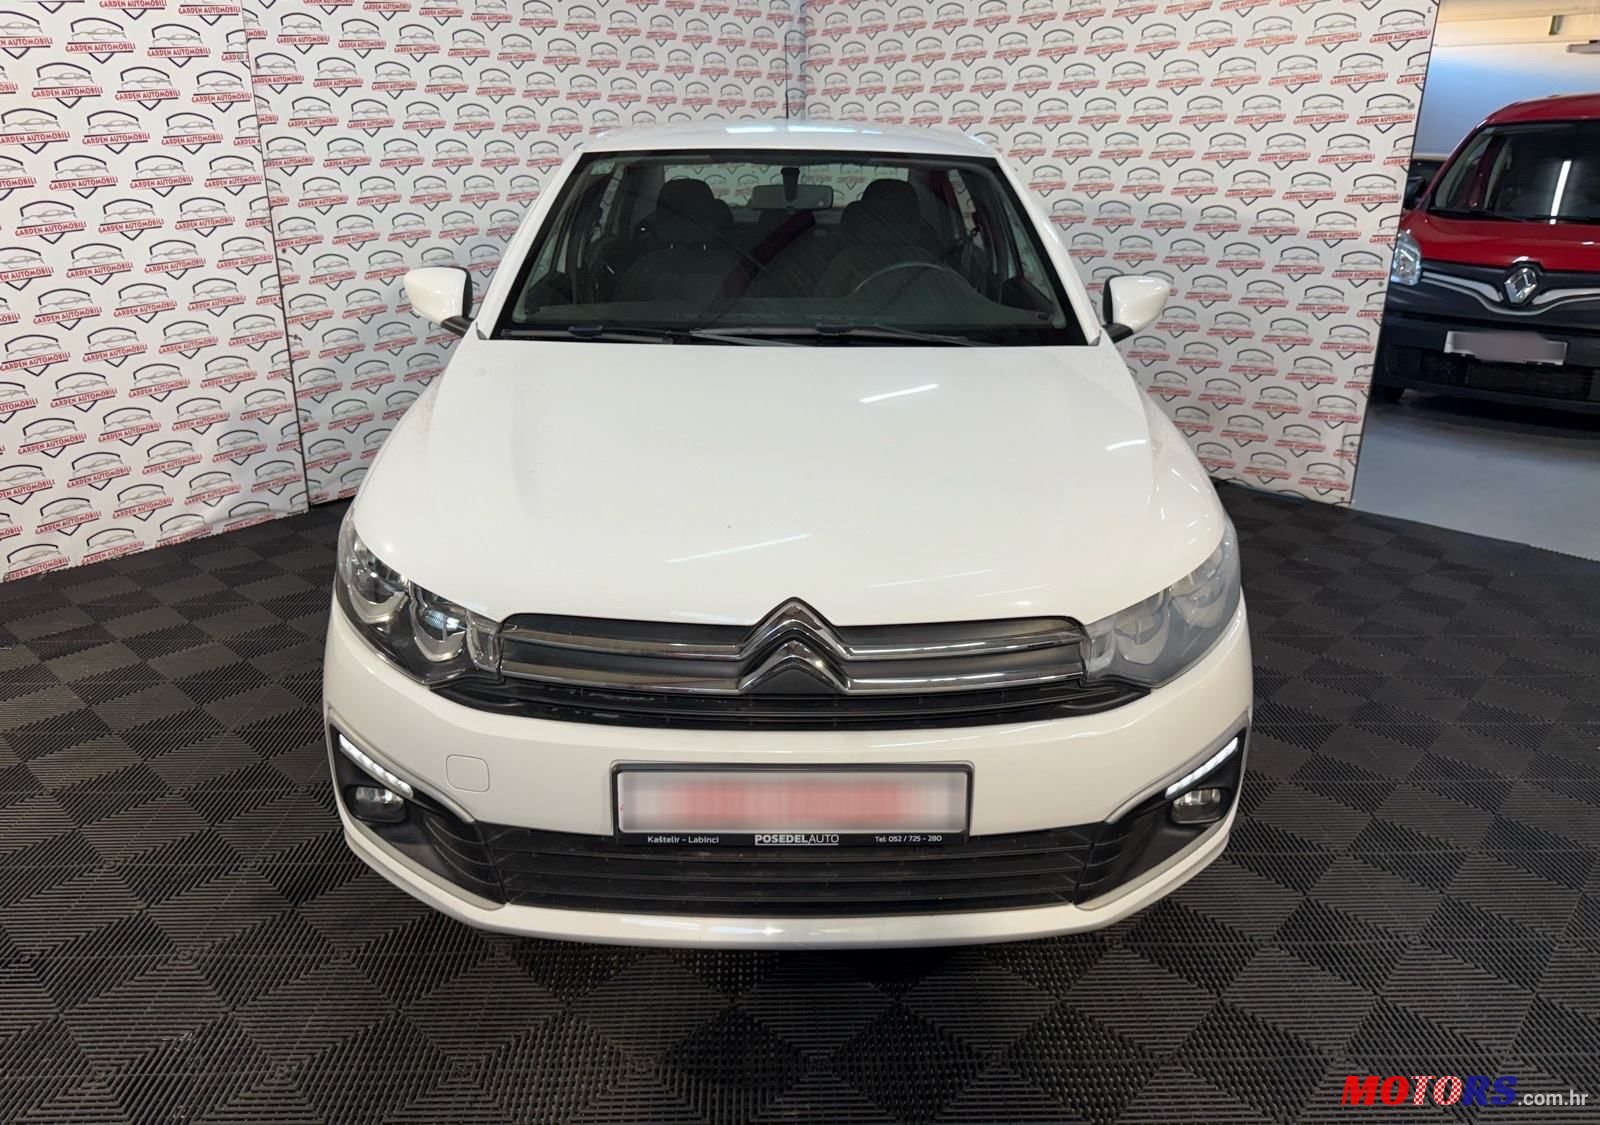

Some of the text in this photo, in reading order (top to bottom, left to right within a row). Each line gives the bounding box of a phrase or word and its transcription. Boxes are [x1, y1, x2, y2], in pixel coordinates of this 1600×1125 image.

[8, 37, 53, 46] AUTOMOBILI
[94, 42, 136, 51] AUTOMOBILI
[173, 47, 211, 55] AUTOMOBILI
[31, 86, 103, 98] GARDEN AUTOMOBILI
[115, 89, 181, 101] GARDEN AUTOMOBILI
[0, 131, 70, 144] ARDEN AUTOMOBILI
[82, 132, 150, 145] GARDEN AUTOMOBILI
[161, 133, 223, 146] GARDEN AUTOMOBILI
[49, 176, 119, 190] GARDEN AUTOMOBILI
[130, 175, 194, 189] GARDEN AUTOMOBILI
[15, 227, 43, 237] GARDEN
[44, 220, 87, 233] AUTOMOBILI
[98, 218, 164, 233] GARDEN AUTOMOBILI
[11, 266, 54, 279] AUTOMOBILI
[66, 261, 134, 279] GARDEN AUTOMOBILI
[145, 257, 207, 274] GARDEN AUTOMOBILI
[33, 314, 60, 325] GARDEN
[62, 306, 102, 319] AUTOMOBILI
[113, 300, 177, 318] GARDEN AUTOMOBILI
[0, 351, 71, 372] GARDEN AUTOMOBILI
[82, 343, 148, 363] GARDEN AUTOMOBILI
[128, 378, 190, 398] GARDEN AUTOMOBILI
[50, 387, 118, 409] GARDEN AUTOMOBILI
[98, 421, 162, 443] GARDEN AUTOMOBILI
[18, 443, 45, 455] GARDEN
[46, 432, 87, 448] AUTOMOBILI
[66, 465, 132, 489] GARDEN AUTOMOBILI
[13, 478, 55, 495] AUTOMOBILI
[112, 496, 174, 520] GARDEN AUTOMOBILI
[35, 509, 102, 535] GARDEN AUTOMOBILI
[688, 836, 720, 844] Labinci
